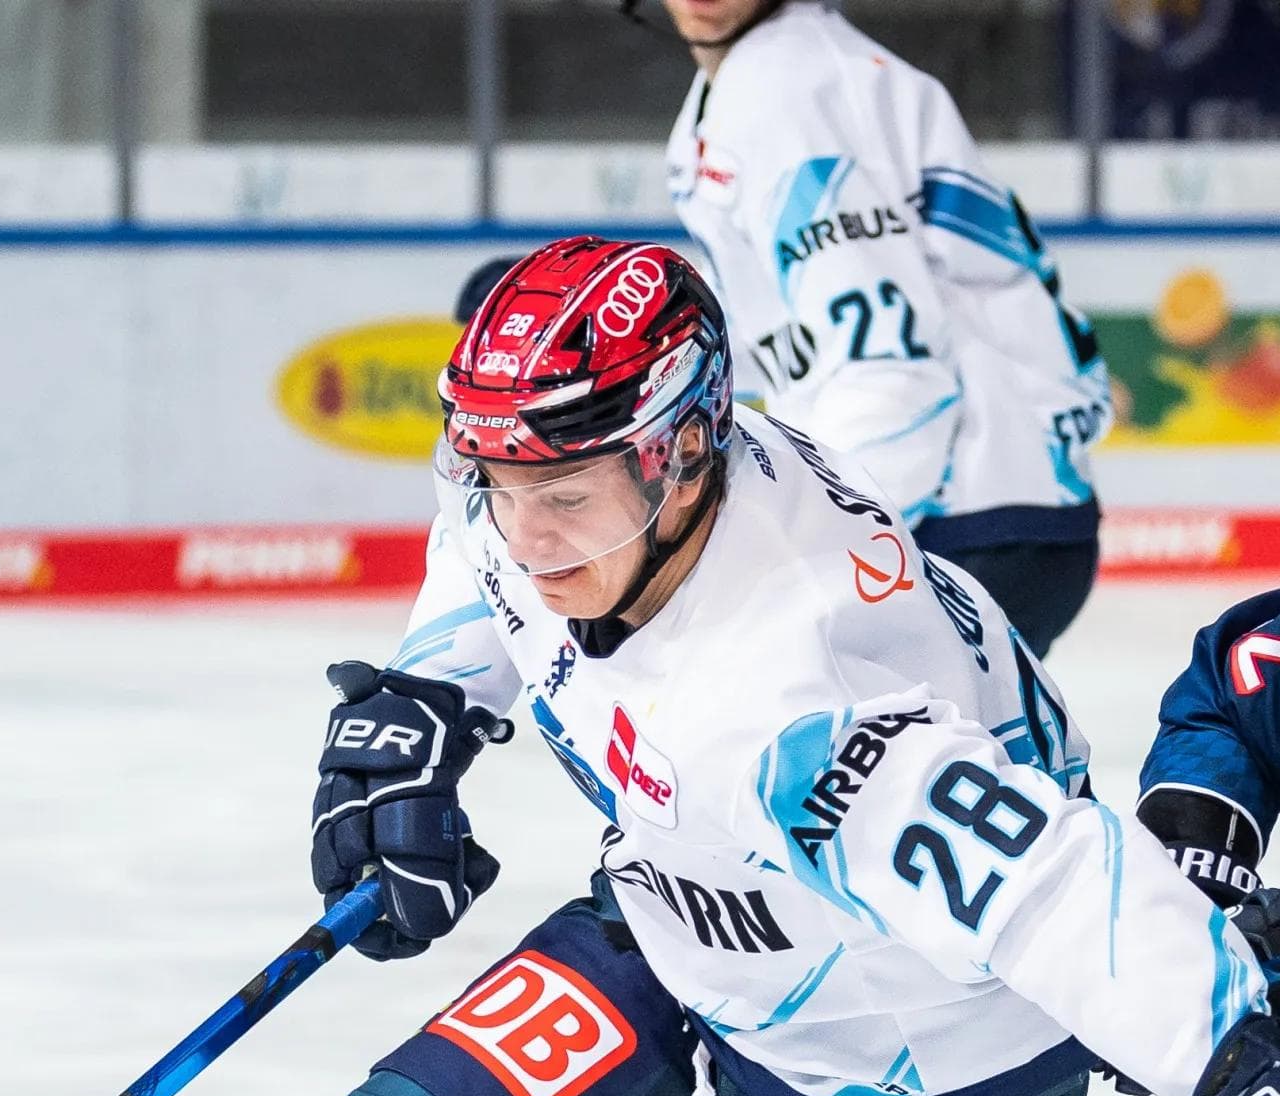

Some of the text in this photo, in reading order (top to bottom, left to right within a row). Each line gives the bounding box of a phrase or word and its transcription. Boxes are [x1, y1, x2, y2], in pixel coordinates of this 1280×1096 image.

[500, 313, 535, 337] 28
[827, 278, 932, 362] 22
[890, 759, 1049, 937] 28
[451, 964, 602, 1083] DB
